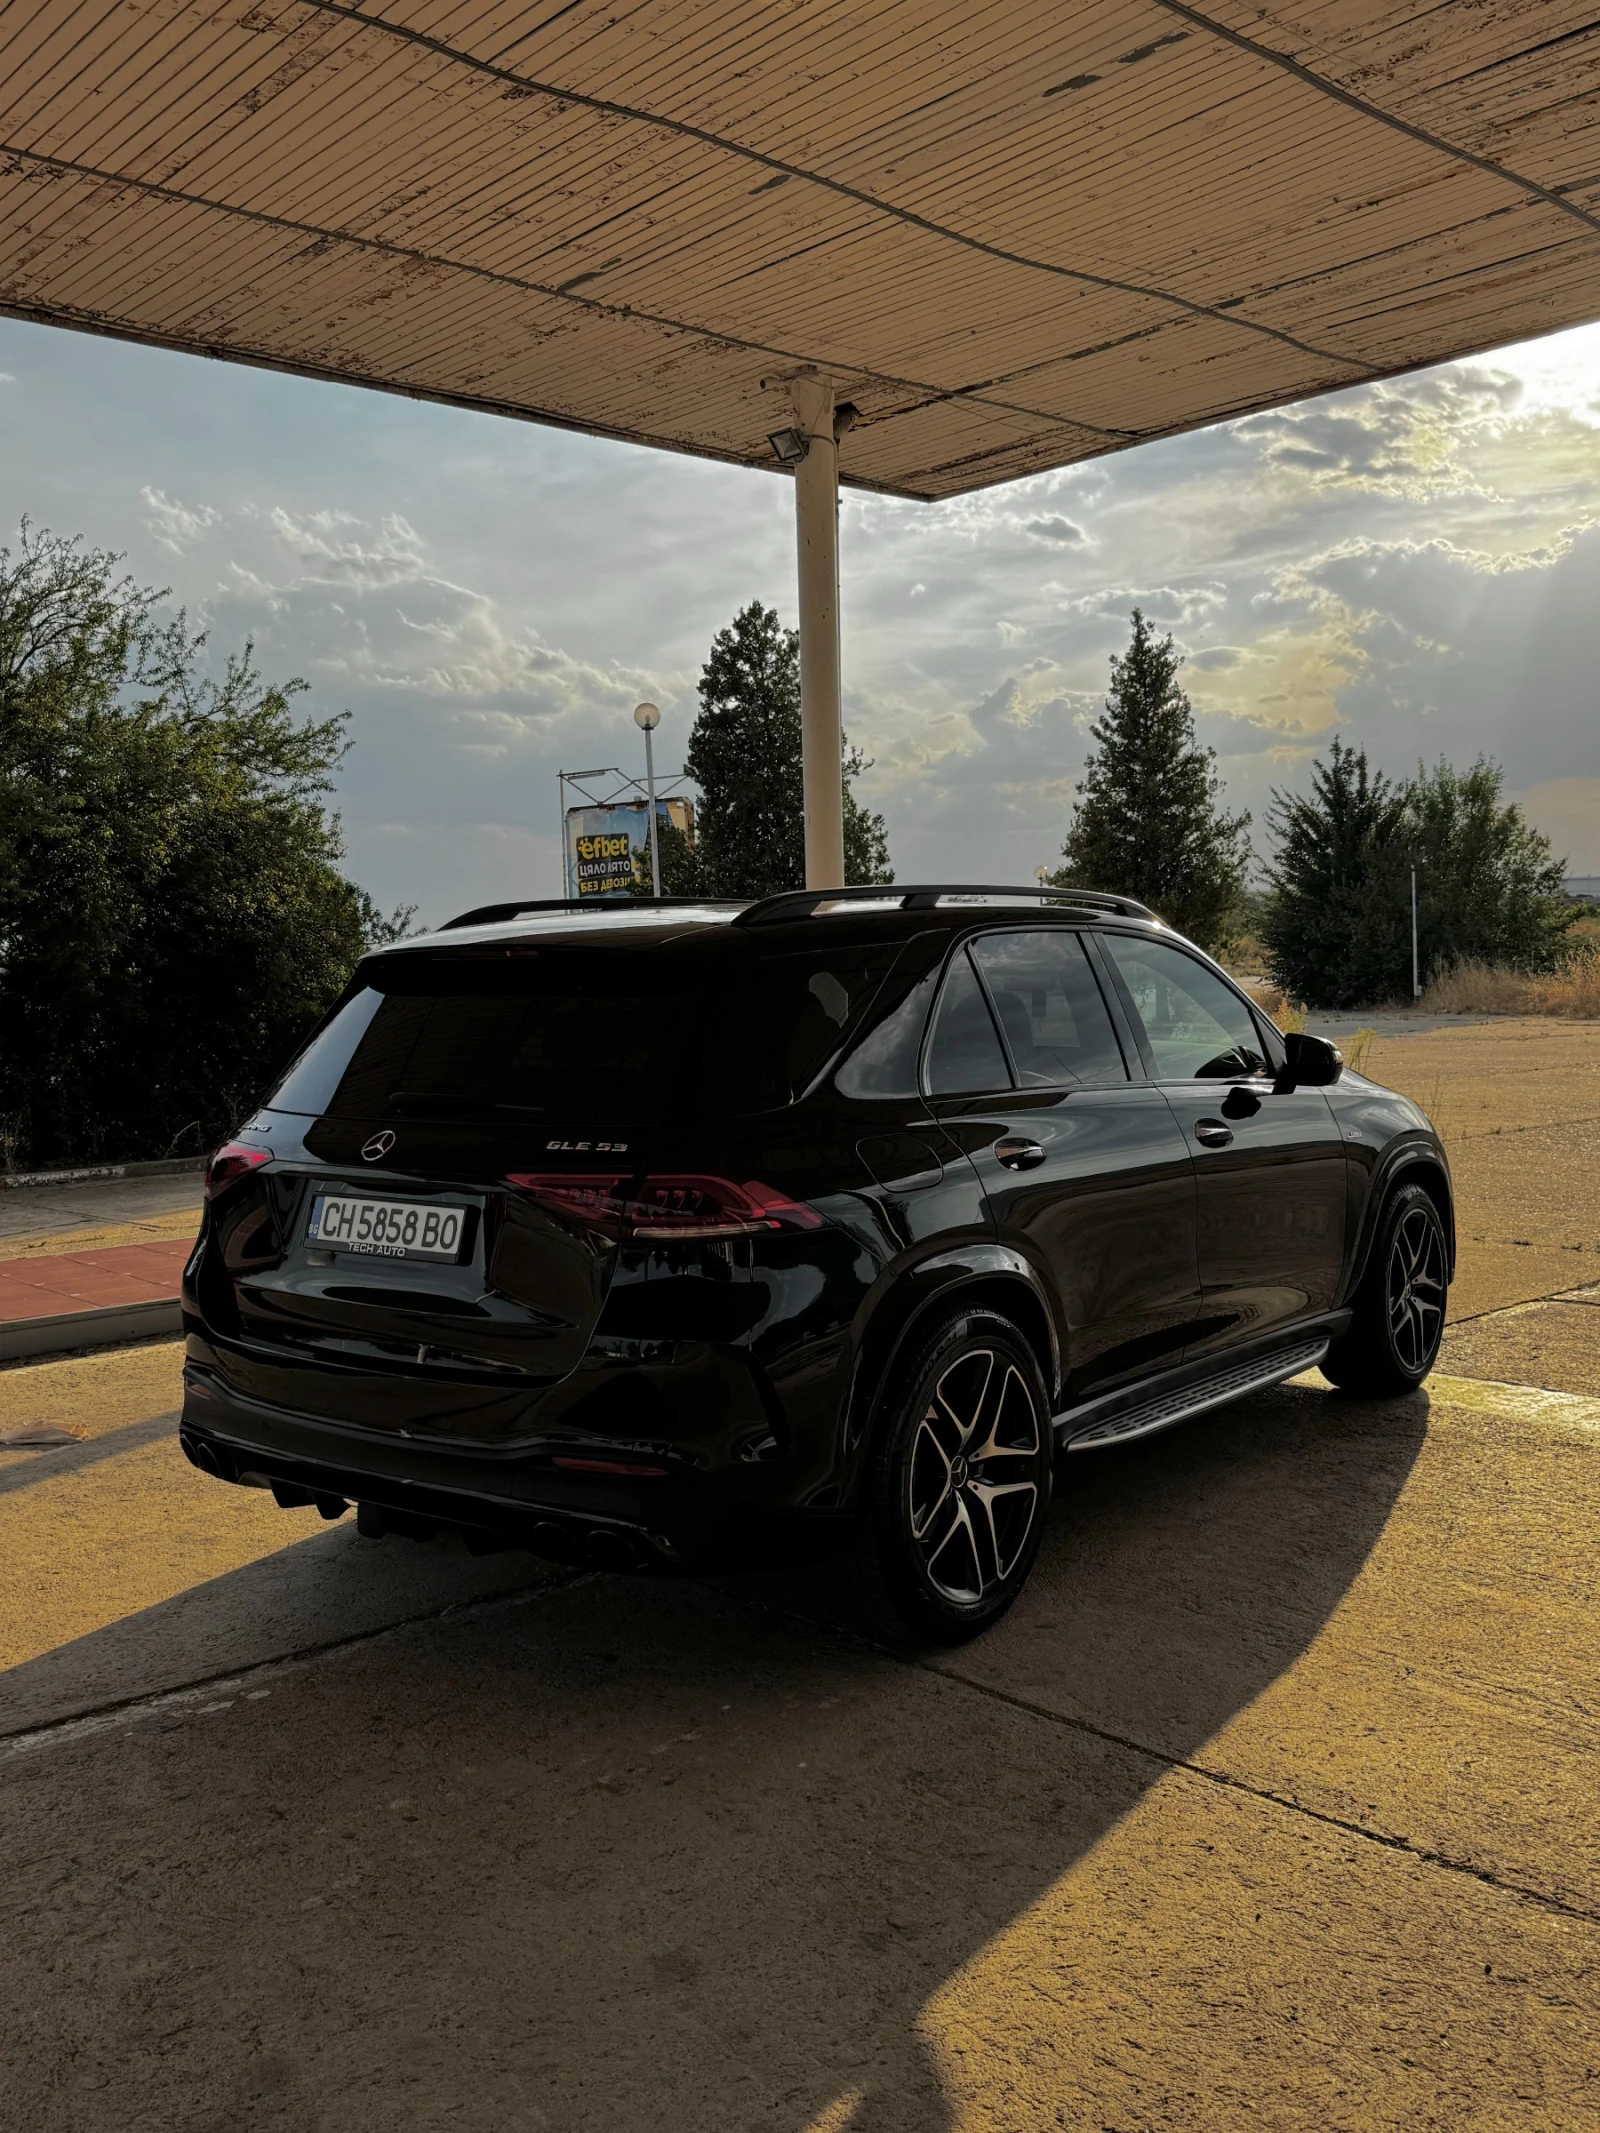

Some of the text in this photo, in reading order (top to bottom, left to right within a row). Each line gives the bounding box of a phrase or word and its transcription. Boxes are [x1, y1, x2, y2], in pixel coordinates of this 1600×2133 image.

[581, 836, 628, 860] efbet
[579, 863, 606, 877] ЦЯЛО
[580, 877, 630, 893] БЕЗ ДЕПОЗИ
[546, 1140, 628, 1152] GLE 53
[308, 1223, 319, 1234] BG
[357, 1205, 418, 1245] 5858
[347, 1242, 406, 1257] TECH AUTO
